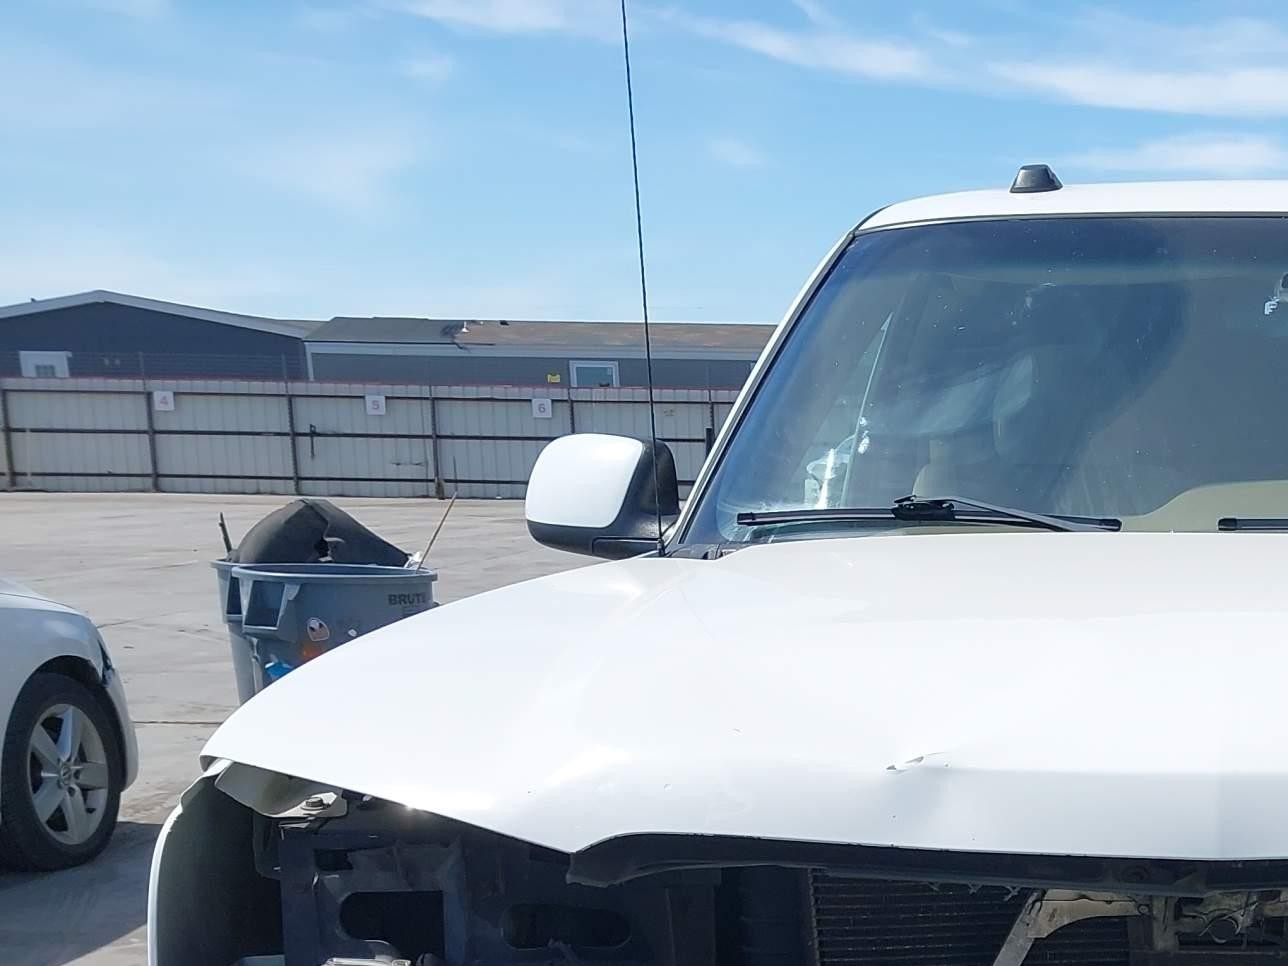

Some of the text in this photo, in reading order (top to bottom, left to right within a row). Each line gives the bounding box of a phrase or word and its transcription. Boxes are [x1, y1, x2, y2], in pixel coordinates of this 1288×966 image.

[159, 395, 168, 405] 4
[371, 400, 380, 410] 5
[538, 403, 546, 413] 6
